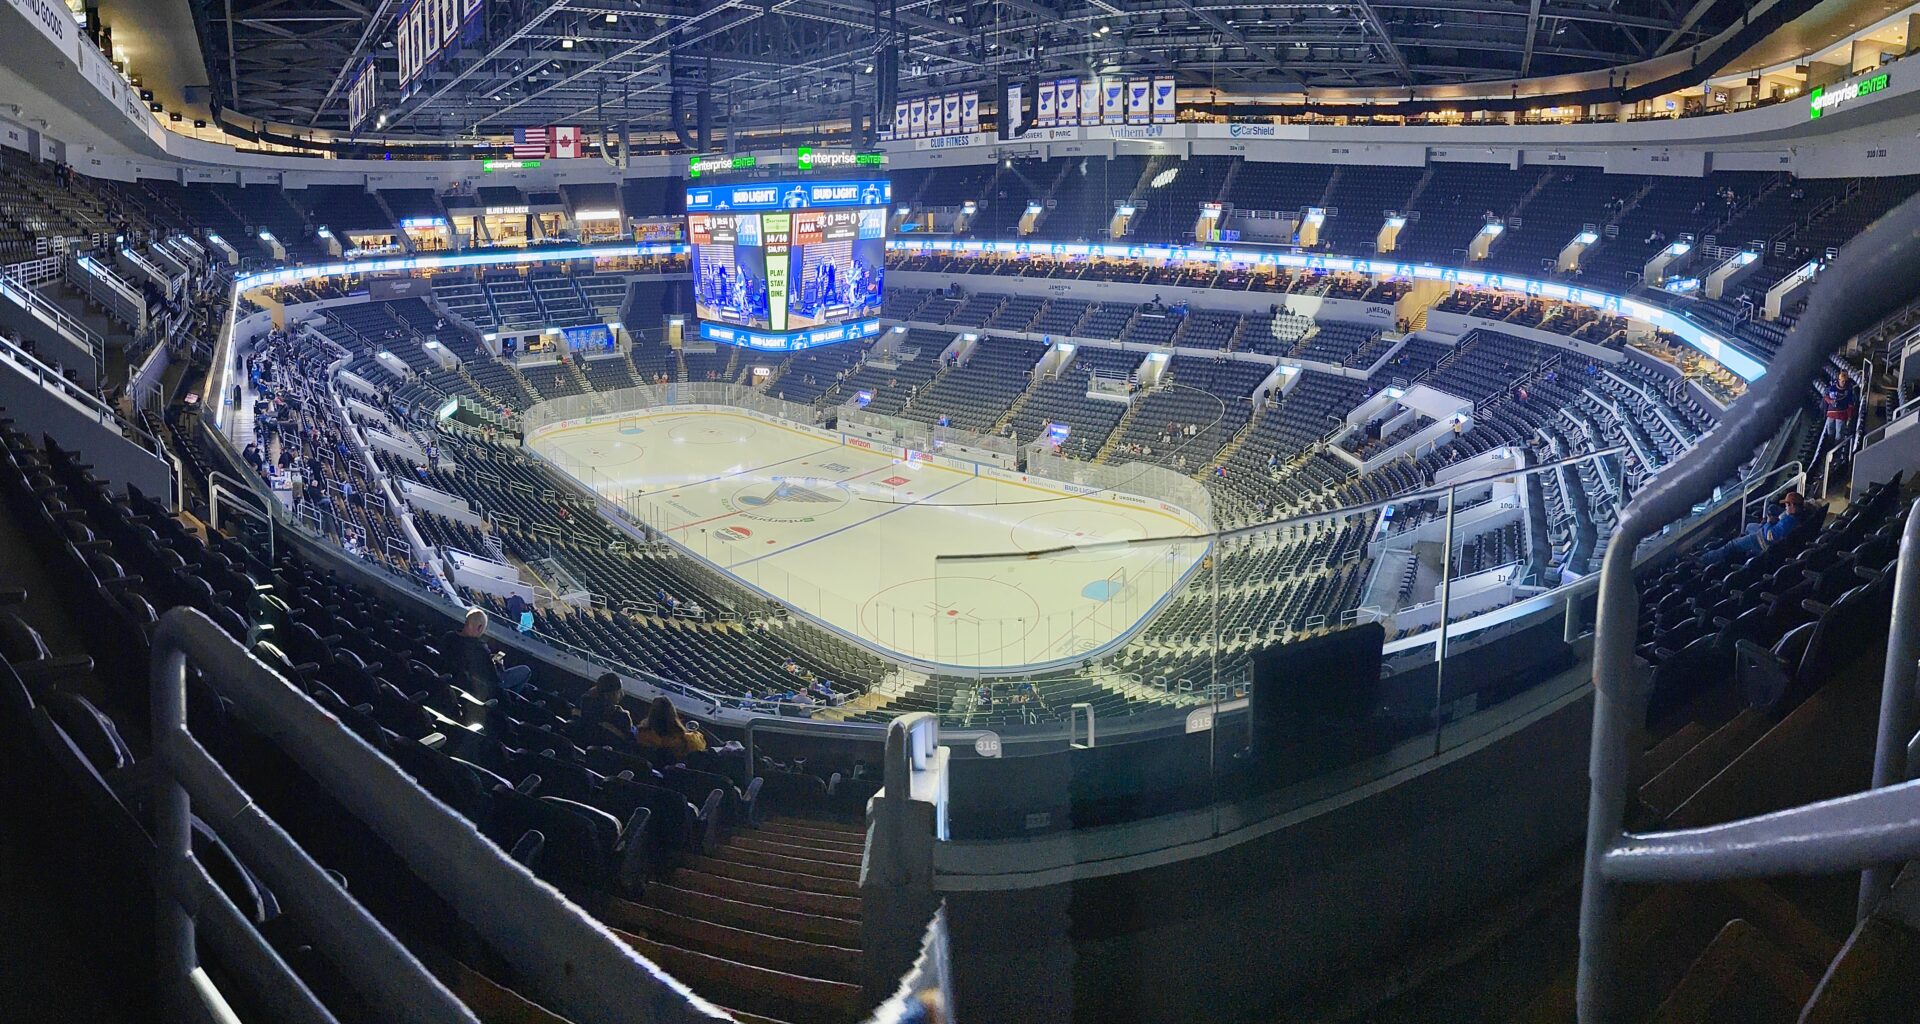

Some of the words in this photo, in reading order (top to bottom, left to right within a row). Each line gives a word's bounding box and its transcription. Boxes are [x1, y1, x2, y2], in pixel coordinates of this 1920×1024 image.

[41, 1, 63, 40] GOODS
[1813, 83, 1858, 110] enterprise
[1857, 74, 1887, 96] CENTER
[1110, 126, 1144, 138] Anthem
[1242, 126, 1275, 136] CarShield
[930, 137, 945, 148] CLUB
[946, 136, 969, 147] FITNESS
[692, 158, 732, 172] enterprise
[732, 157, 756, 168] CENTER
[800, 153, 856, 165] enterprise
[856, 154, 882, 164] CENTER
[733, 191, 749, 203] BUD
[749, 189, 776, 201] LIGHT
[813, 188, 829, 200] BUD
[829, 187, 857, 199] LIGHT
[827, 214, 834, 226] 0
[850, 212, 857, 224] 0
[800, 222, 815, 233] ANA
[770, 269, 785, 277] PLAY.
[770, 279, 785, 287] STAY.
[770, 290, 785, 298] DINE.
[1365, 306, 1391, 316] JAMESON
[848, 437, 871, 449] verizon
[1064, 484, 1079, 492] BUD
[1190, 718, 1212, 729] 315
[976, 739, 998, 751] 316
